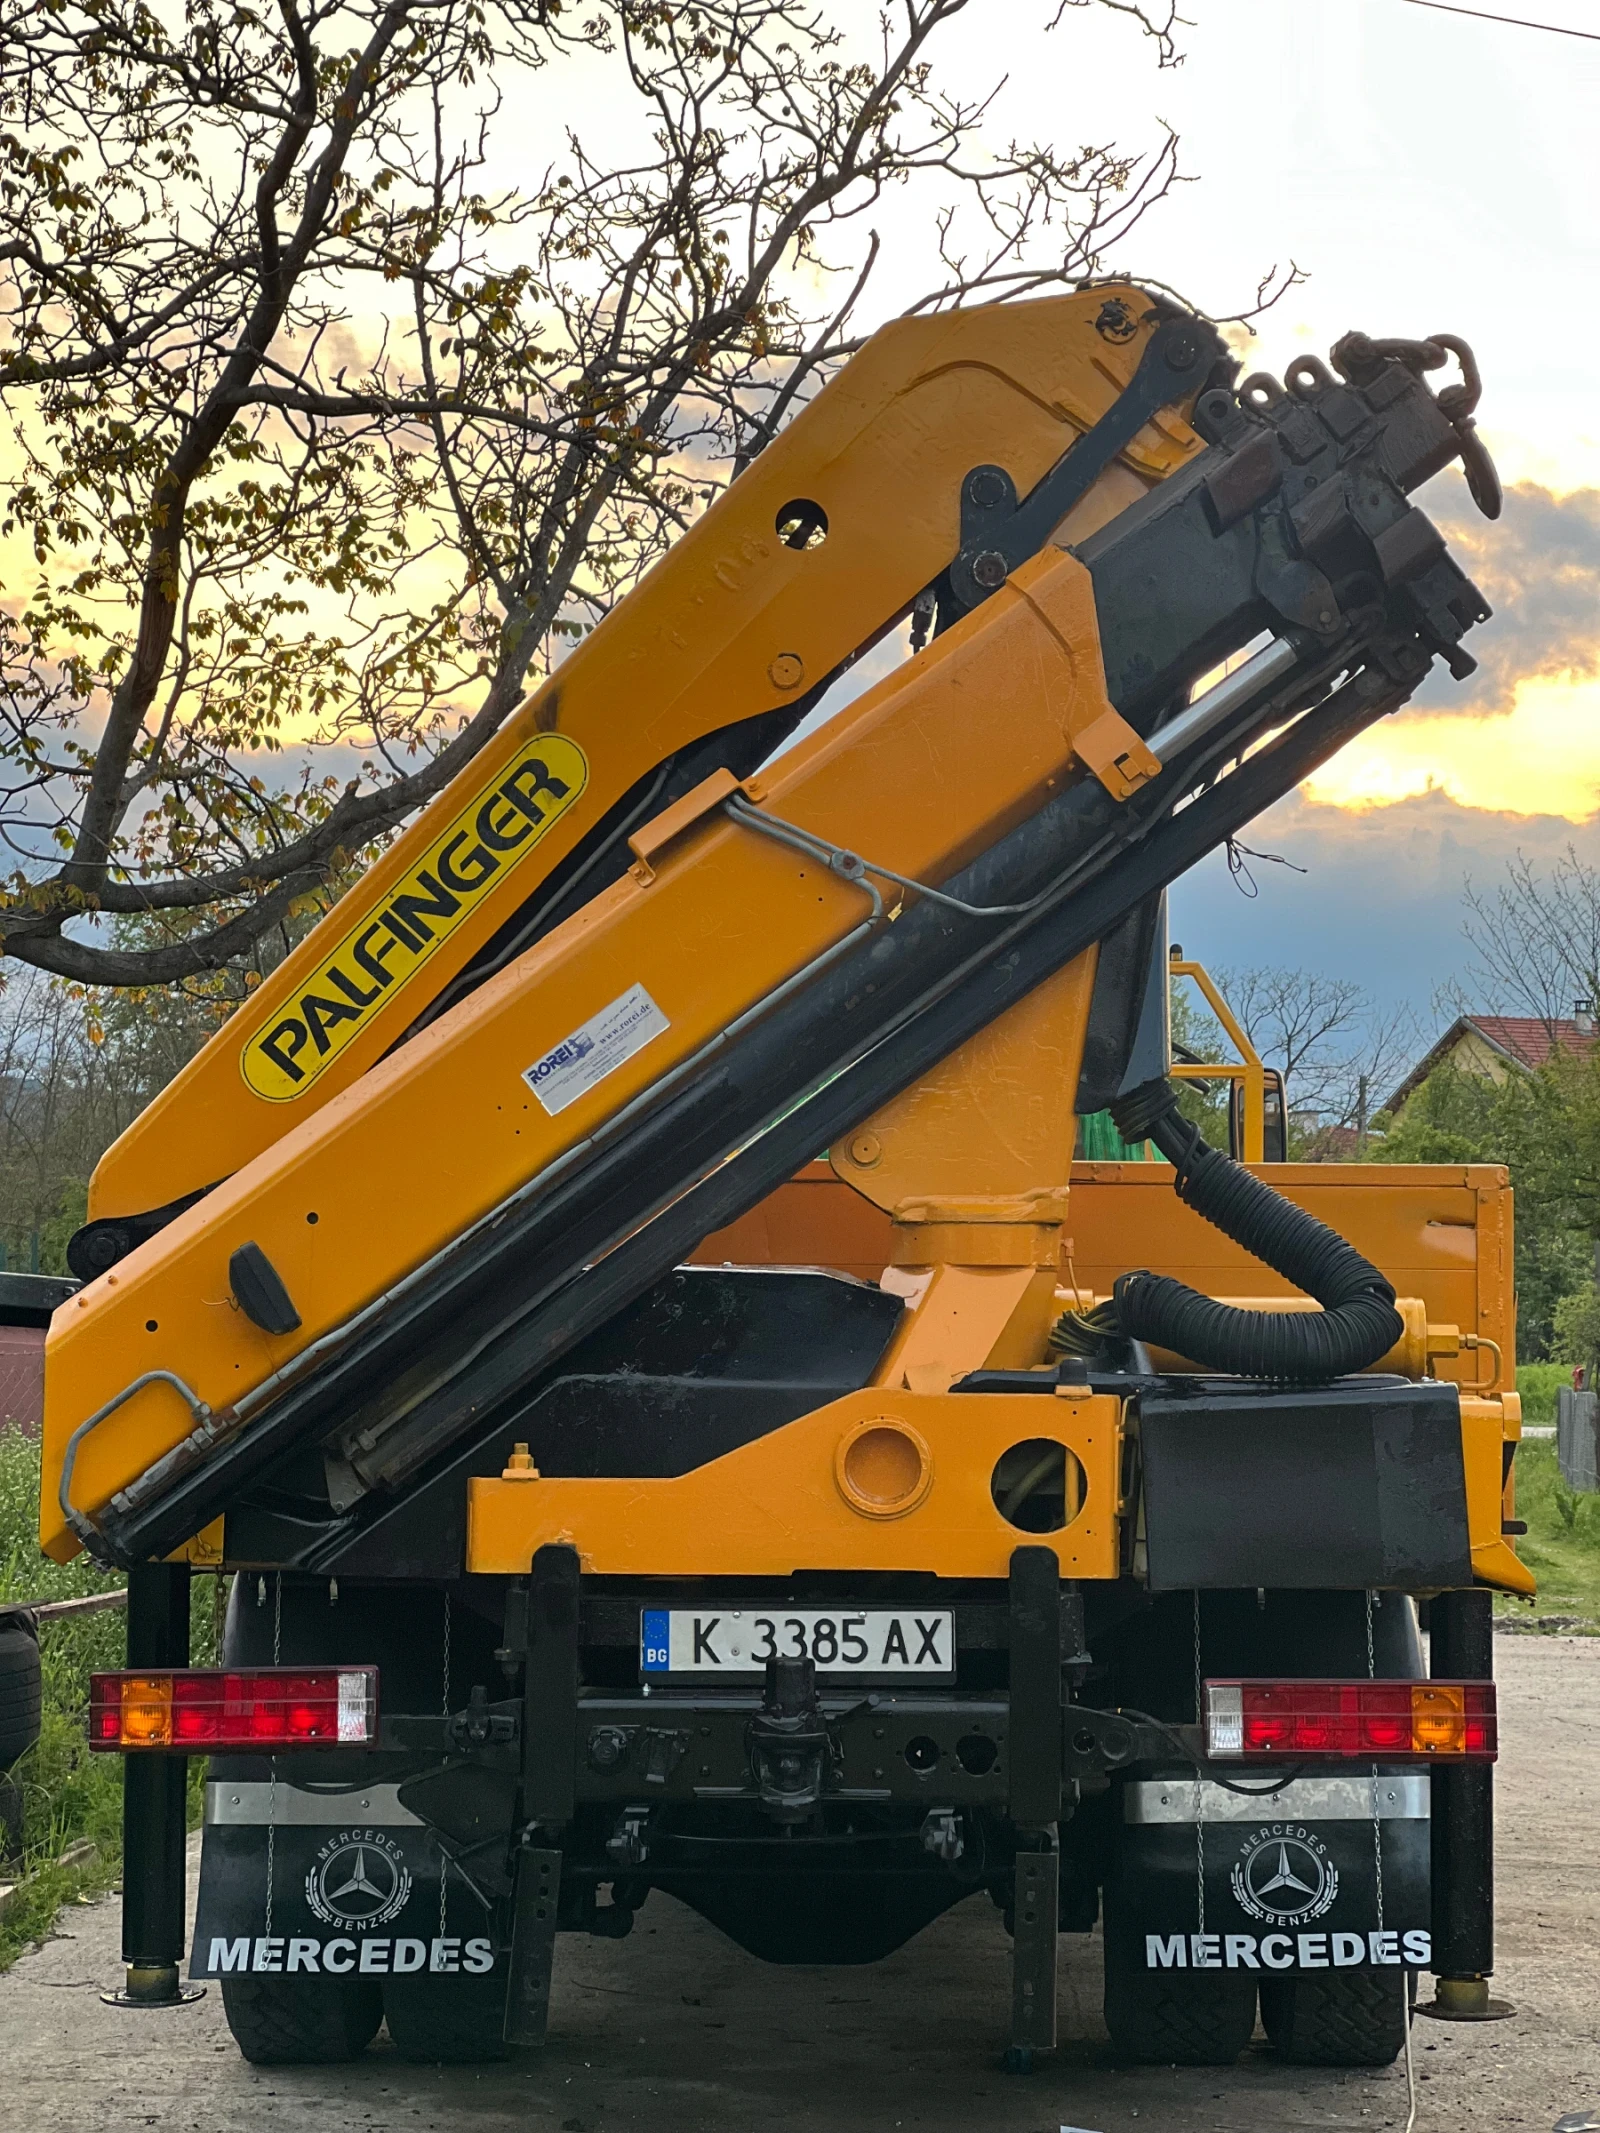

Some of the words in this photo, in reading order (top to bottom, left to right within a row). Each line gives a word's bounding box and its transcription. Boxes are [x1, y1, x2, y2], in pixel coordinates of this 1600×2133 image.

[259, 758, 571, 1083] PALFINGER
[599, 1003, 651, 1044] www.rorei.de
[527, 1044, 574, 1085] ROREI
[647, 1648, 668, 1663] BG
[694, 1618, 721, 1664] K
[751, 1618, 869, 1664] 3385
[881, 1618, 943, 1665] AX
[317, 1829, 404, 1861] MERCEDES
[1240, 1824, 1327, 1857] MERCEDES
[332, 1917, 381, 1931] BENZ
[1265, 1912, 1312, 1926] BENZ
[207, 1937, 495, 1974] MERCEDES
[1145, 1929, 1432, 1970] MERCEDES
